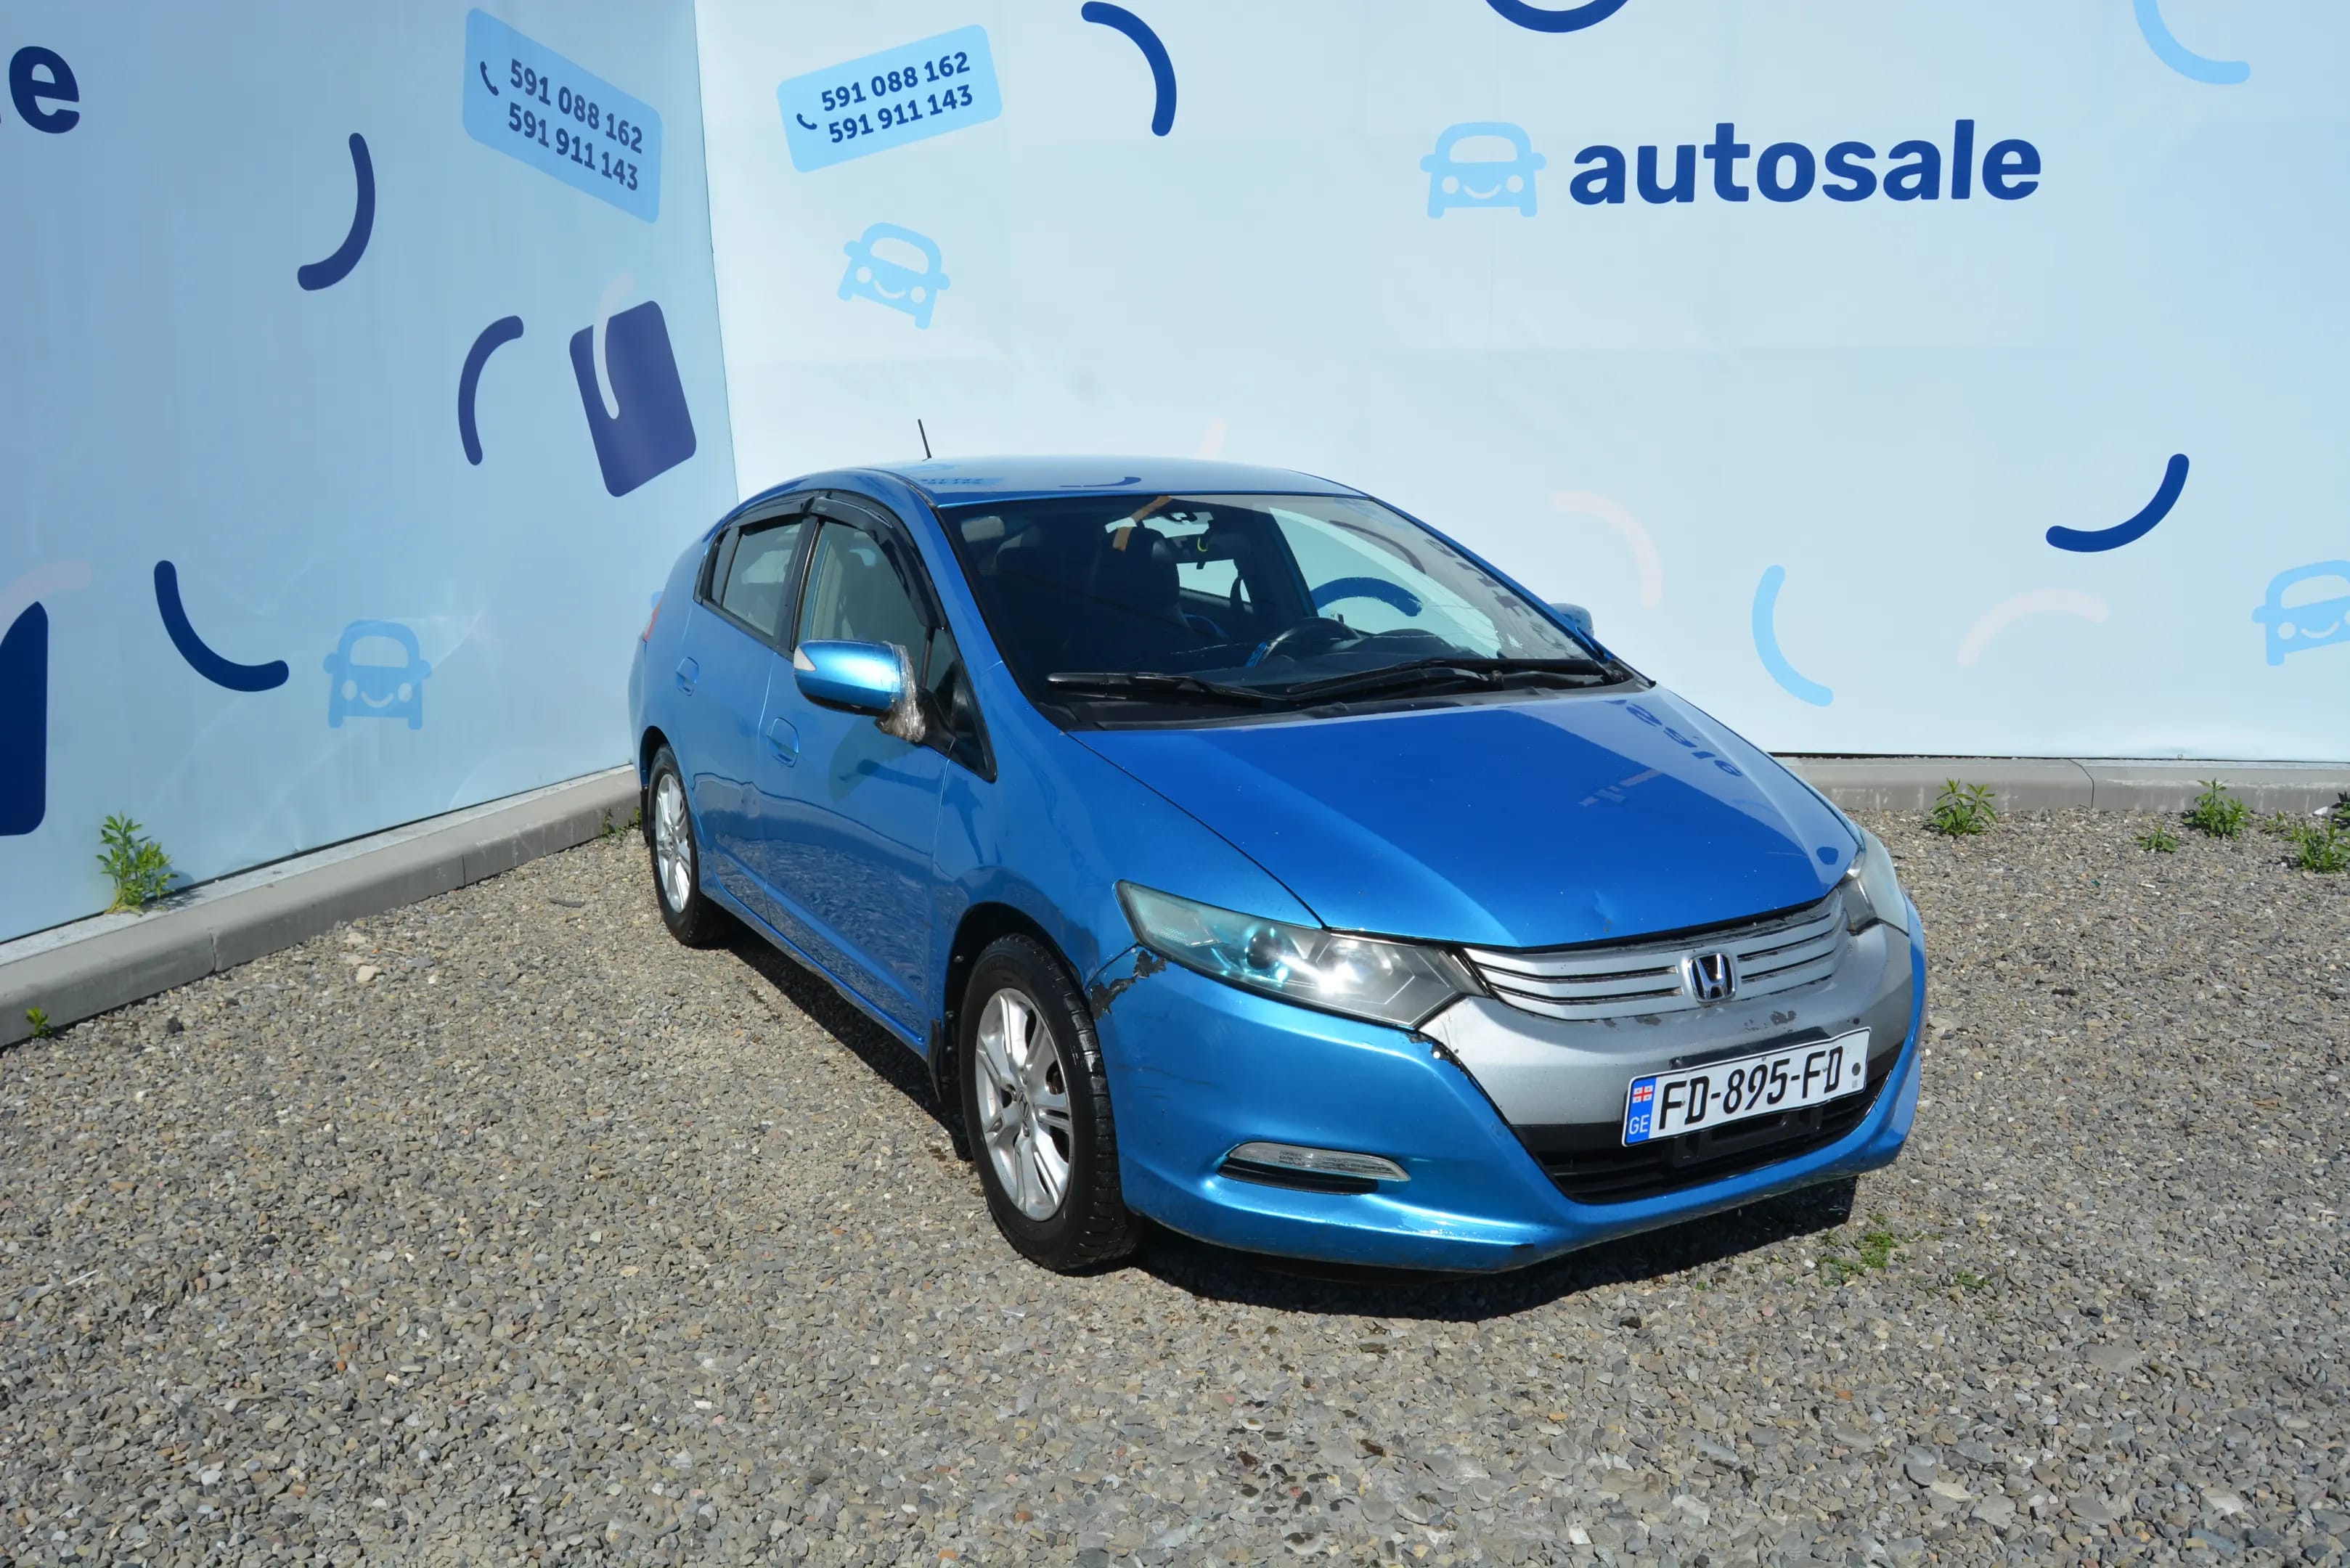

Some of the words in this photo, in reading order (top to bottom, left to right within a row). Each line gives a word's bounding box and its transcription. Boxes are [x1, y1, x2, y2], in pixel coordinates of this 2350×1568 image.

[0, 46, 80, 134] e
[510, 58, 551, 107] 591
[558, 86, 600, 130] 088
[605, 113, 642, 155] 162
[821, 81, 867, 112] 591
[870, 66, 918, 97] 088
[923, 52, 971, 83] 162
[828, 113, 874, 143] 591
[877, 99, 923, 130] 911
[927, 84, 973, 116] 143
[508, 101, 550, 149] 591
[555, 128, 596, 171] 911
[601, 151, 638, 191] 143
[1570, 119, 2041, 205] autosale
[1628, 1114, 1650, 1135] GE
[1658, 1045, 1844, 1130] FD-895-FD
